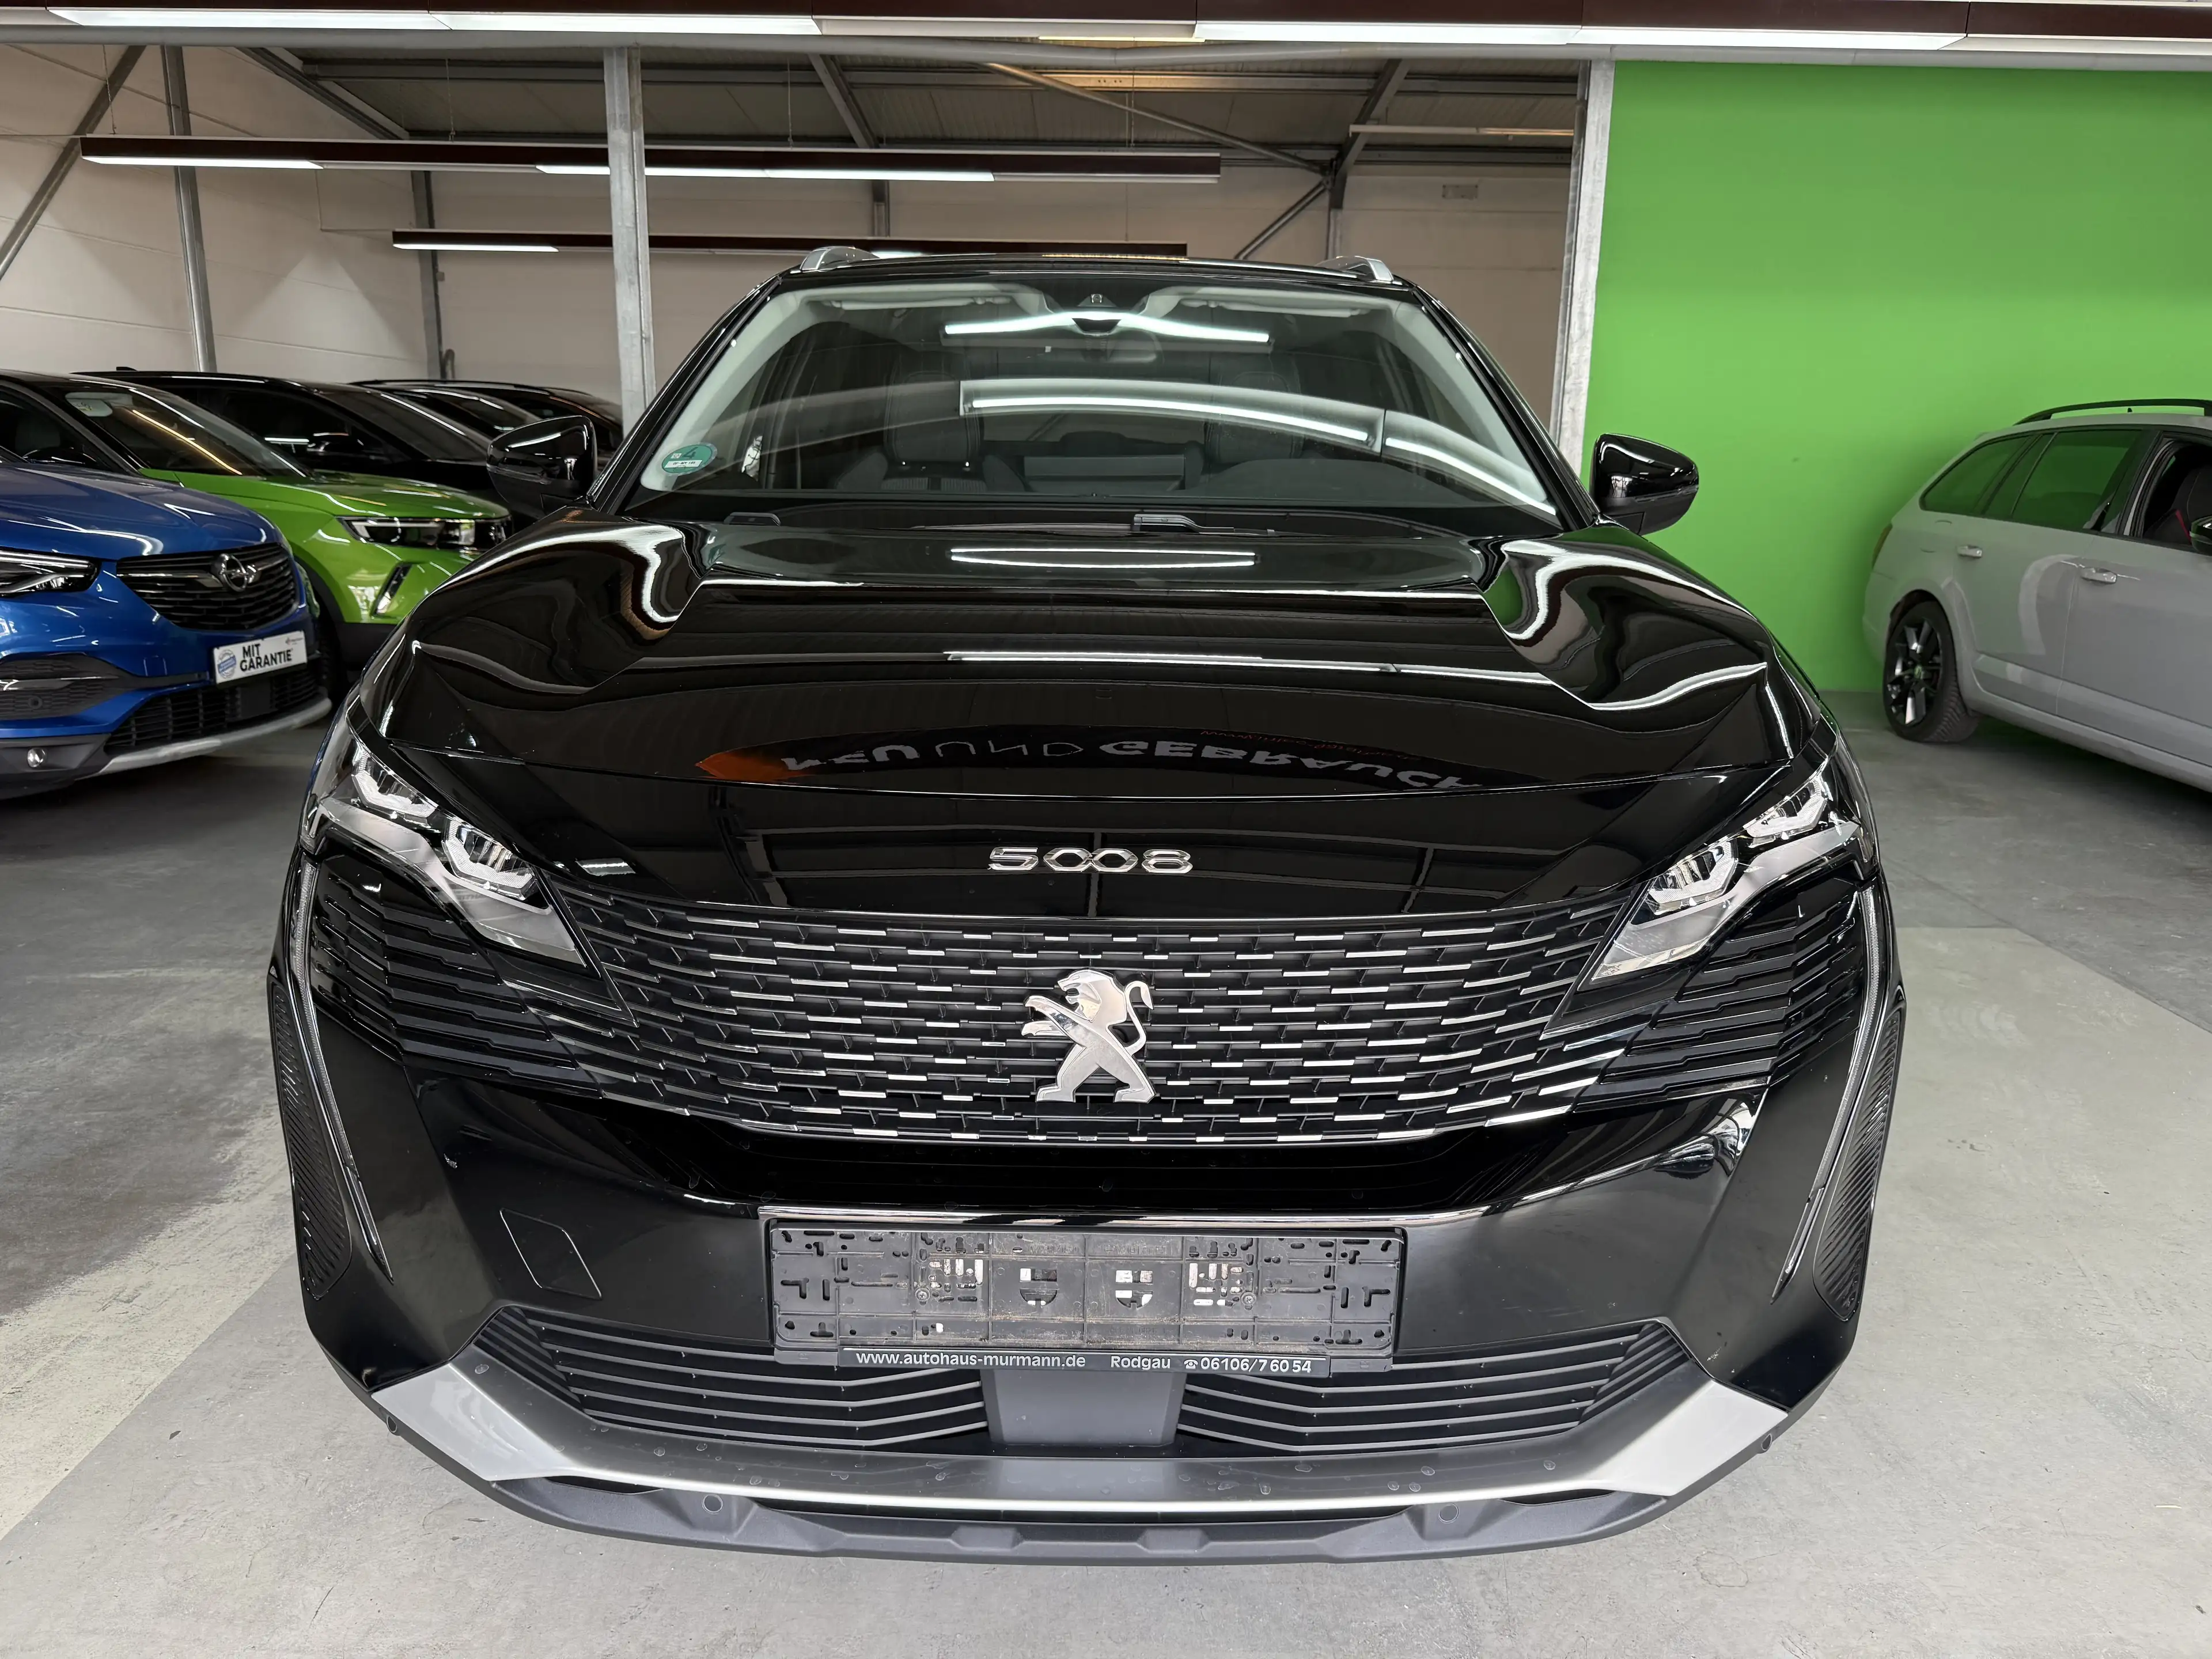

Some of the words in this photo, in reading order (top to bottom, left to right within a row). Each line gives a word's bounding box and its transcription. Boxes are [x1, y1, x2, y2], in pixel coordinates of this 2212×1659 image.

[682, 446, 698, 459] 4
[242, 643, 261, 658] MIT
[240, 649, 292, 672] GARANTIE
[989, 847, 1193, 874] 5008
[857, 1353, 1086, 1367] www.autohaus-murmann.de
[1111, 1356, 1171, 1369] Rodgau
